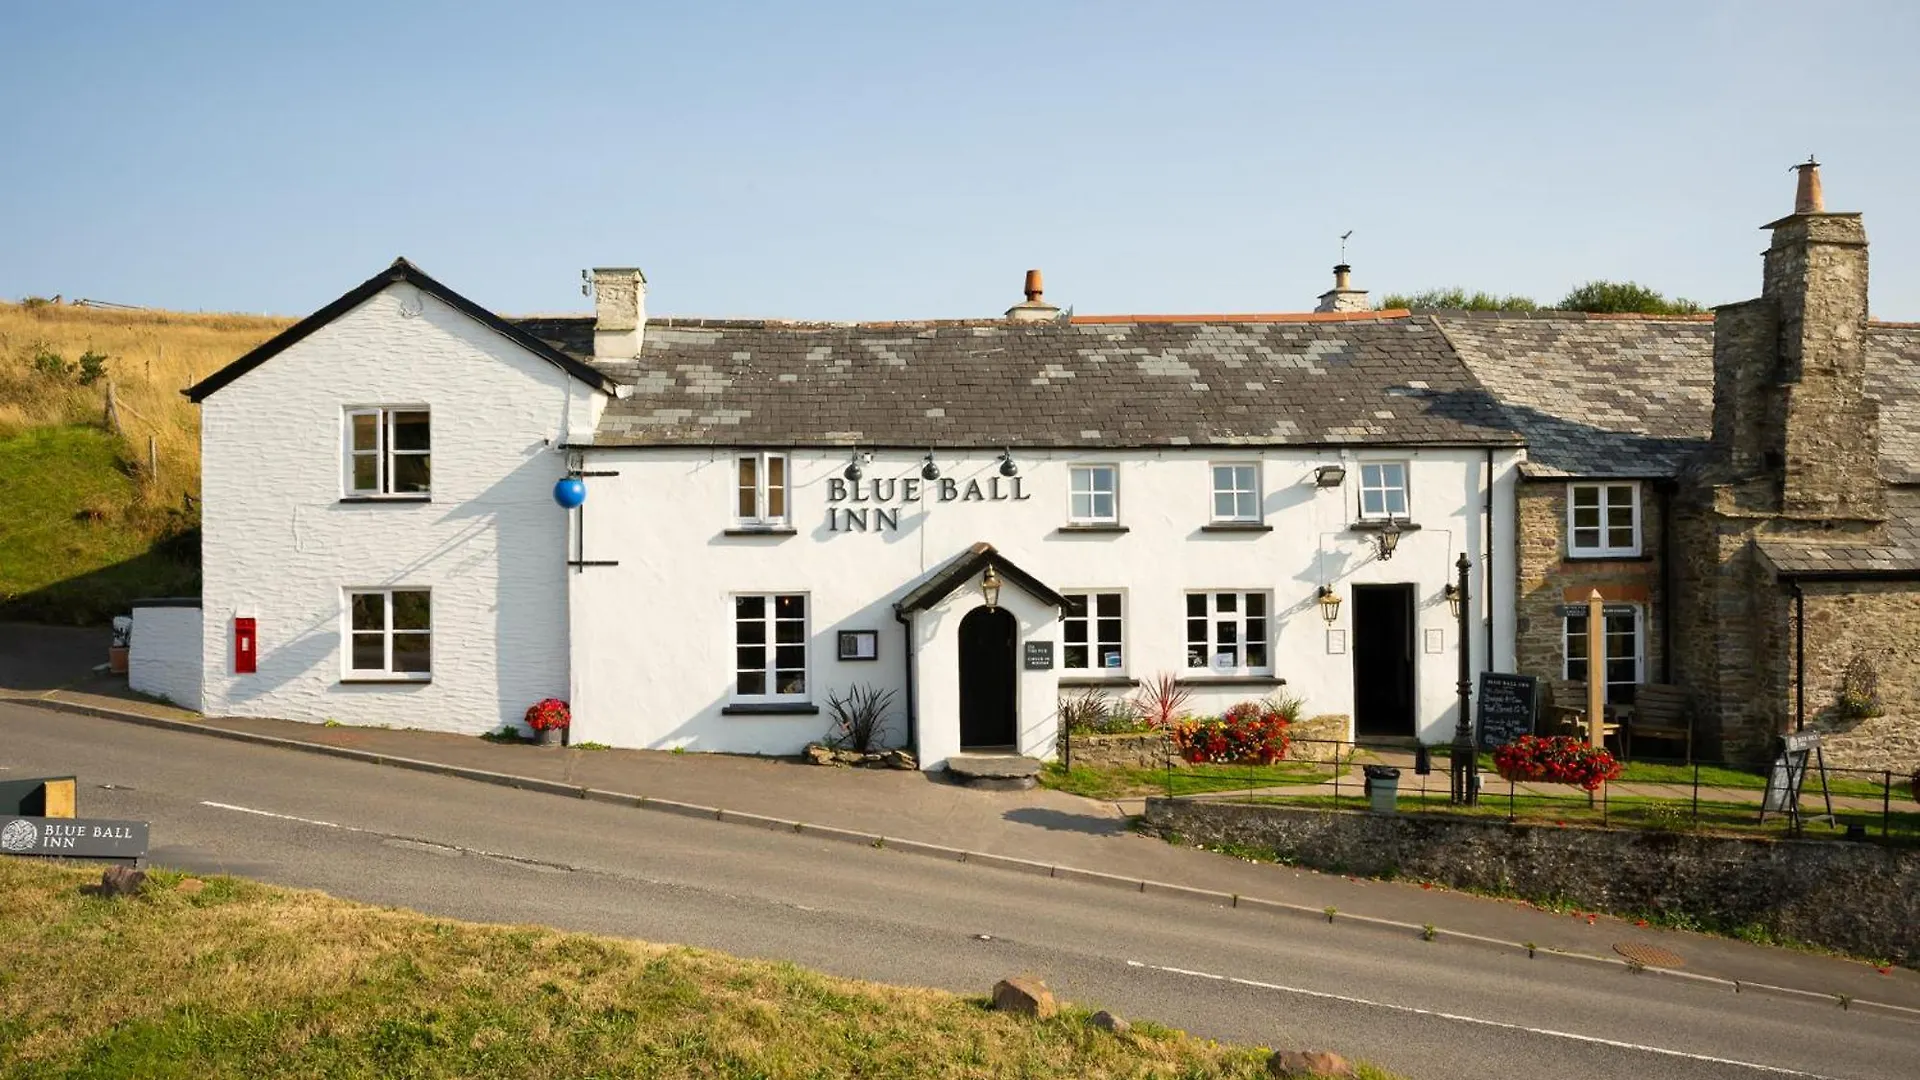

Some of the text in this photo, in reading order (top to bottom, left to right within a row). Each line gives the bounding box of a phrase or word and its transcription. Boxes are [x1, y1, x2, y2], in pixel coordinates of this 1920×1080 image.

[828, 476, 1031, 501] BLUE BALL
[828, 507, 899, 532] INN
[44, 824, 133, 839] BLUE BALL
[43, 836, 75, 848] INN
